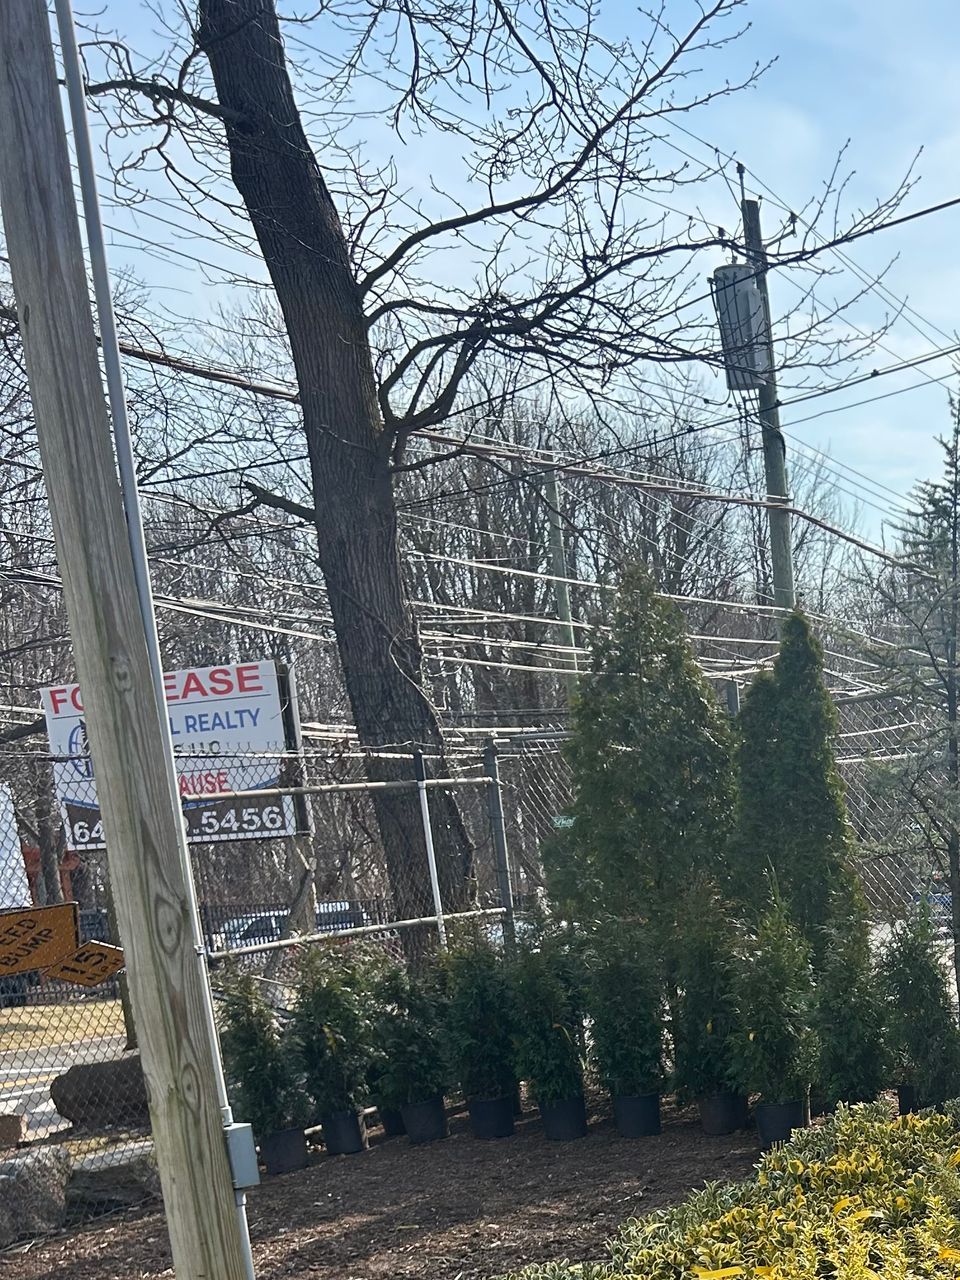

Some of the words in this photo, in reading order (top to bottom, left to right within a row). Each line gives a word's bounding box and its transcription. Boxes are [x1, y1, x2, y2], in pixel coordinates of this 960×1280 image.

[50, 687, 84, 714] FO
[163, 665, 263, 700] EASE
[184, 707, 260, 733] REALTY
[178, 772, 232, 796] AUSE
[73, 819, 106, 843] 64
[183, 806, 283, 834] .5456
[0, 919, 37, 946] EED
[61, 951, 107, 975] 15
